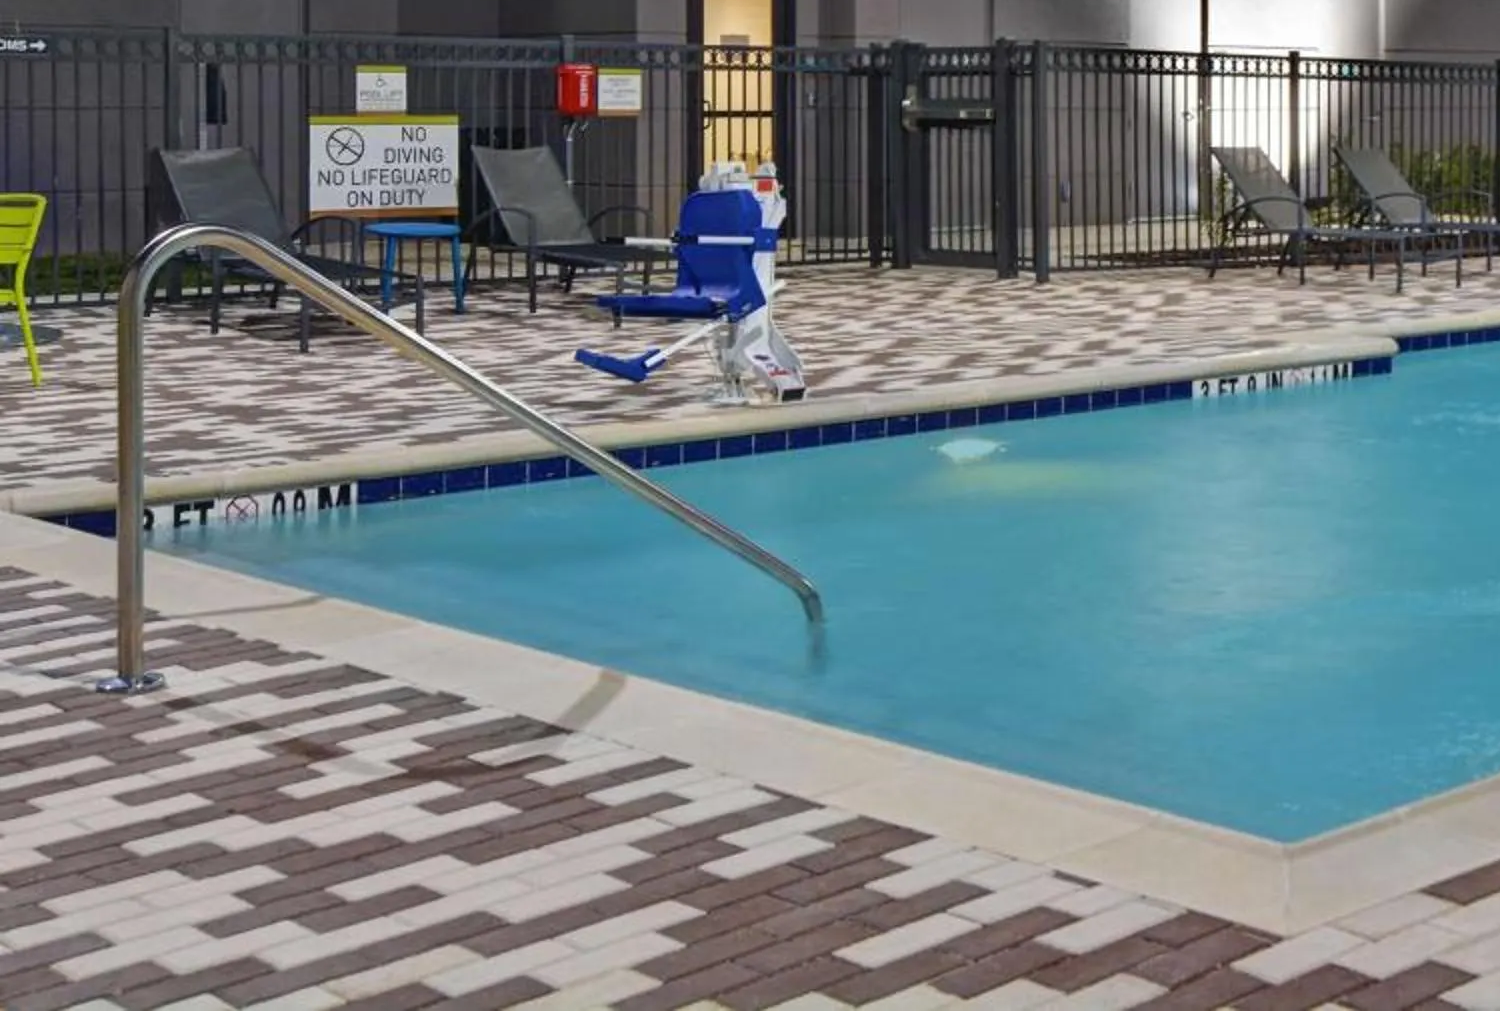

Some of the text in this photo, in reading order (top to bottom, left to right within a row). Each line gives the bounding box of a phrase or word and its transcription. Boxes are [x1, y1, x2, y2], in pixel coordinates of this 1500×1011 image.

[401, 126, 427, 142] NO
[384, 146, 445, 164] DIVING
[317, 167, 453, 187] NO LIFEGUARD
[347, 189, 426, 208] ON DUTY
